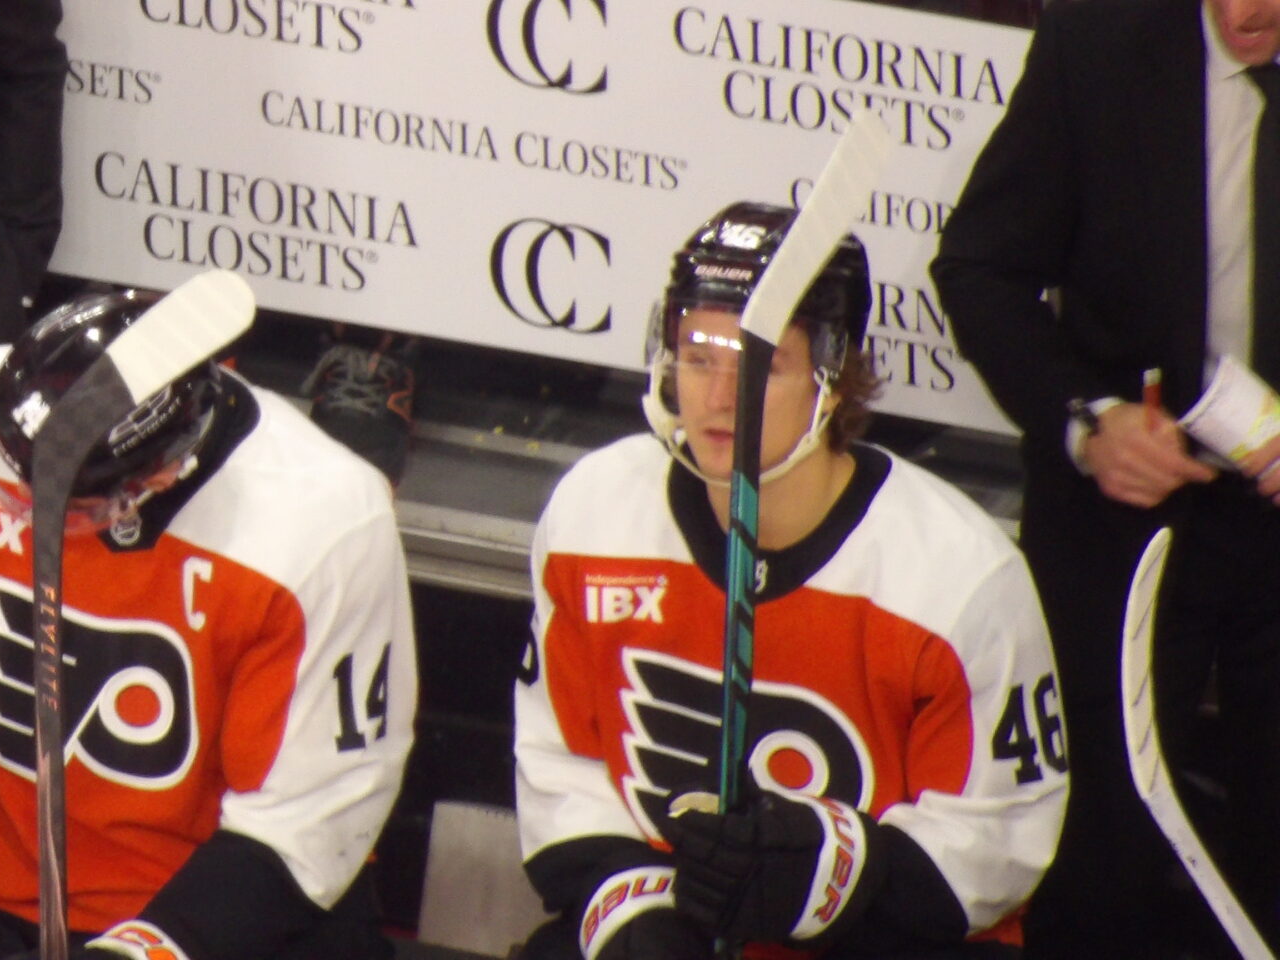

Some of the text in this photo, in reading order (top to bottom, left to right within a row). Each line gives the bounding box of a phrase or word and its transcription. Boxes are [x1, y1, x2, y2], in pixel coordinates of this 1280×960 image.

[66, 59, 153, 104] SETS
[673, 7, 1005, 106] CALIFORNIA
[261, 90, 499, 162] CALIFORNIA
[94, 151, 419, 248] CALIFORNIA
[182, 555, 214, 632] C
[585, 585, 667, 625] IBX
[332, 640, 392, 753] 14
[991, 671, 1069, 785] 46
